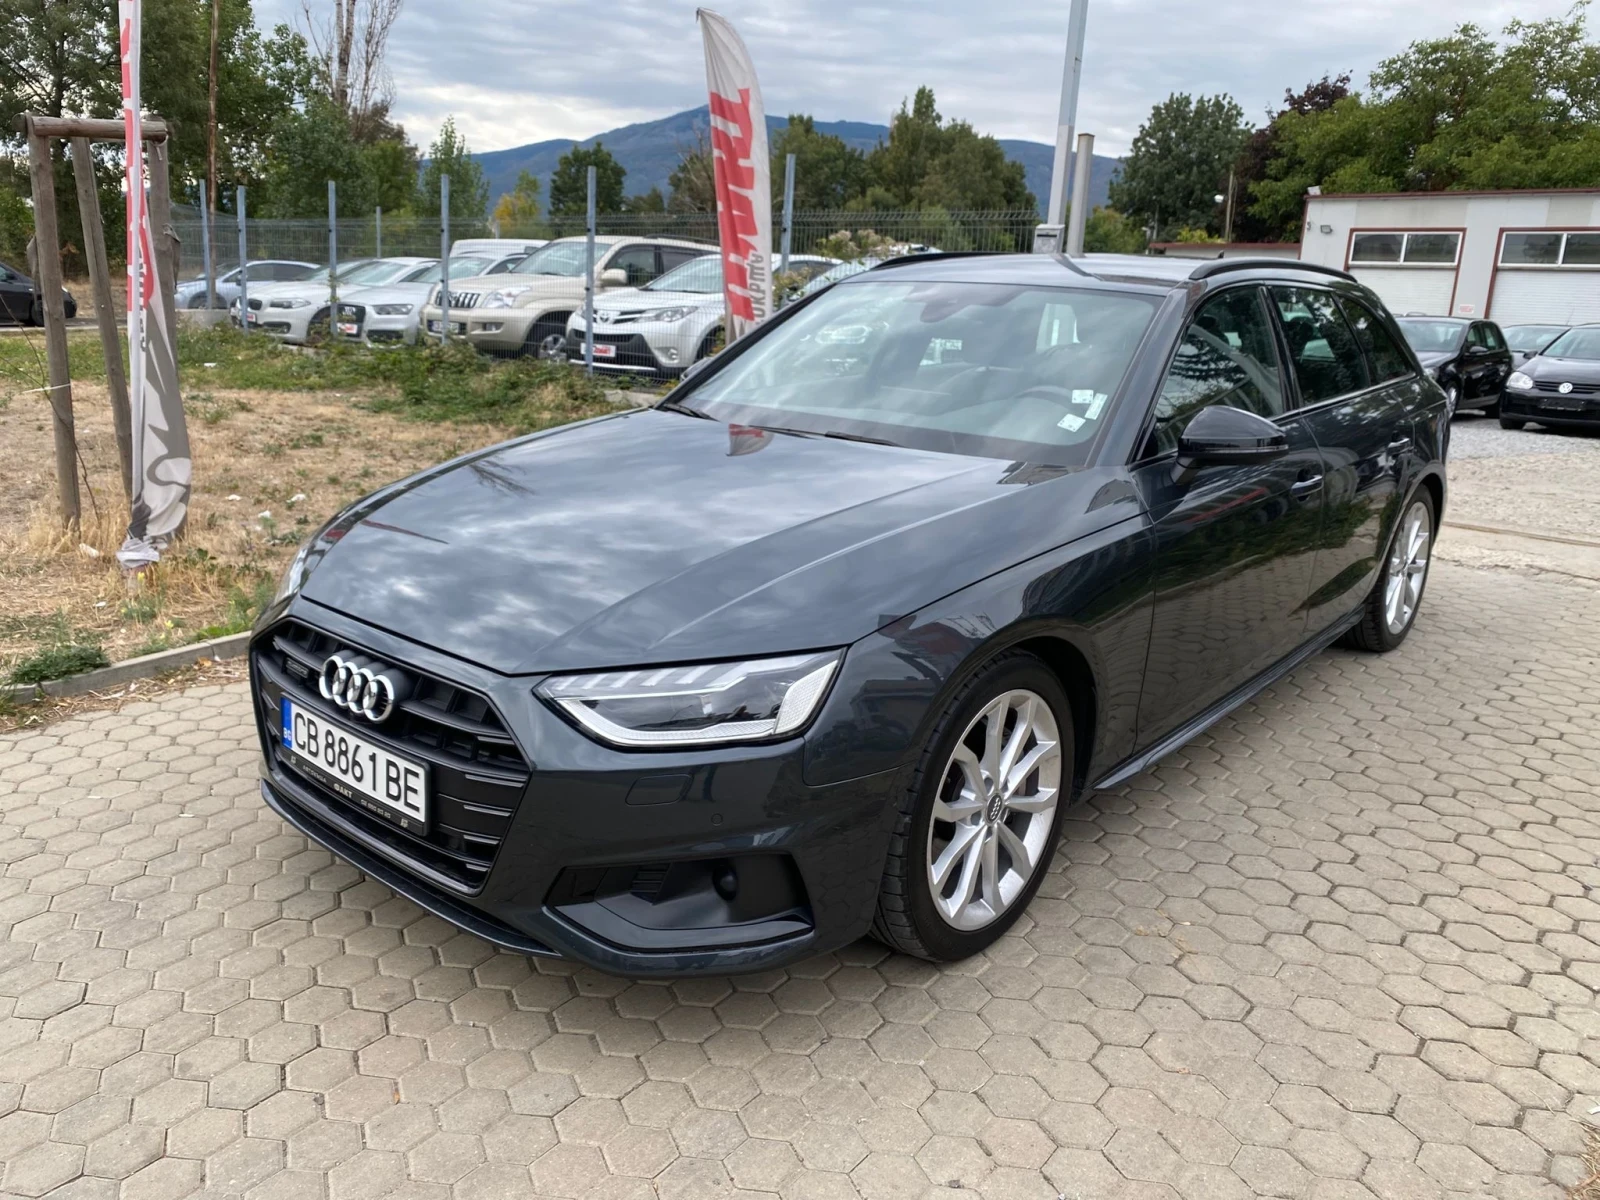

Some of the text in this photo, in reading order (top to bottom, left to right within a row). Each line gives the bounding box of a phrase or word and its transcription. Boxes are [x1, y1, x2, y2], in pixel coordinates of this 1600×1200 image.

[283, 727, 292, 741] BG
[294, 711, 421, 813] CB 8861 BE
